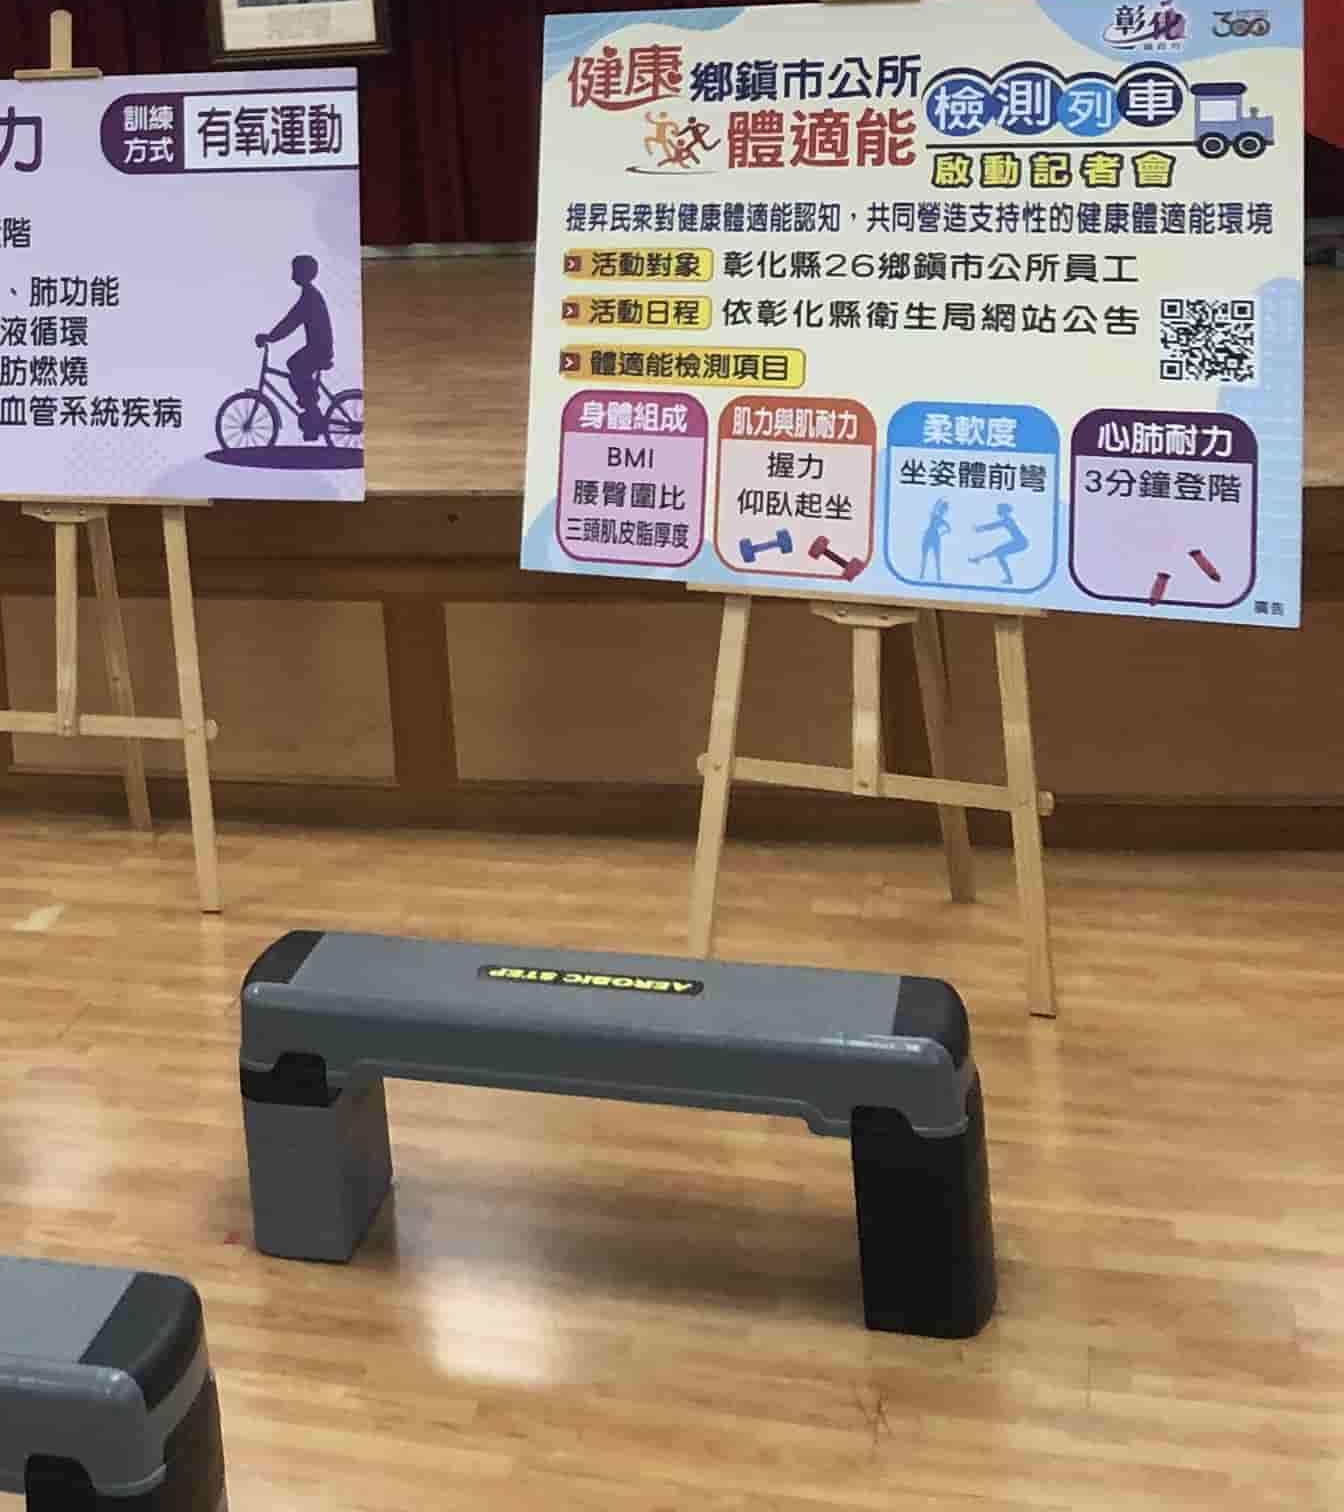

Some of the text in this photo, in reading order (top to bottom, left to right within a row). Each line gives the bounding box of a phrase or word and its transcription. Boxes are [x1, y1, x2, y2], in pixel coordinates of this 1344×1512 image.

[568, 45, 922, 110] 健康 鄉鎮市公所
[124, 104, 174, 133] 訓練
[934, 77, 1178, 133] 檢測列車
[196, 103, 344, 158] 有氧運動
[726, 108, 917, 170] 體適能
[124, 136, 174, 164] 方式
[931, 150, 1178, 190] 啟動記者會
[590, 251, 1138, 284] 活動對象 彰化縣26鄉鎮市公所員工
[588, 296, 1139, 337] 活動日程 依彰化縣衛生局網站公告
[590, 351, 790, 383] 體適能檢測項目
[578, 400, 688, 434] 身體組成
[732, 406, 858, 440] 肌力與肌耐力
[922, 412, 1018, 448] 柔軟度
[1097, 421, 1234, 458] 心肺耐力
[607, 446, 655, 470] BMI
[767, 450, 825, 481] 握力
[900, 459, 1047, 494] 坐姿體前彎
[1085, 467, 1243, 503] 3分鐘登階
[572, 481, 687, 512] 腰臀圍比
[736, 488, 853, 521] 仰臥起坐
[565, 516, 690, 550] 三頭肌皮脂厚度
[562, 973, 693, 993] AEROBIC
